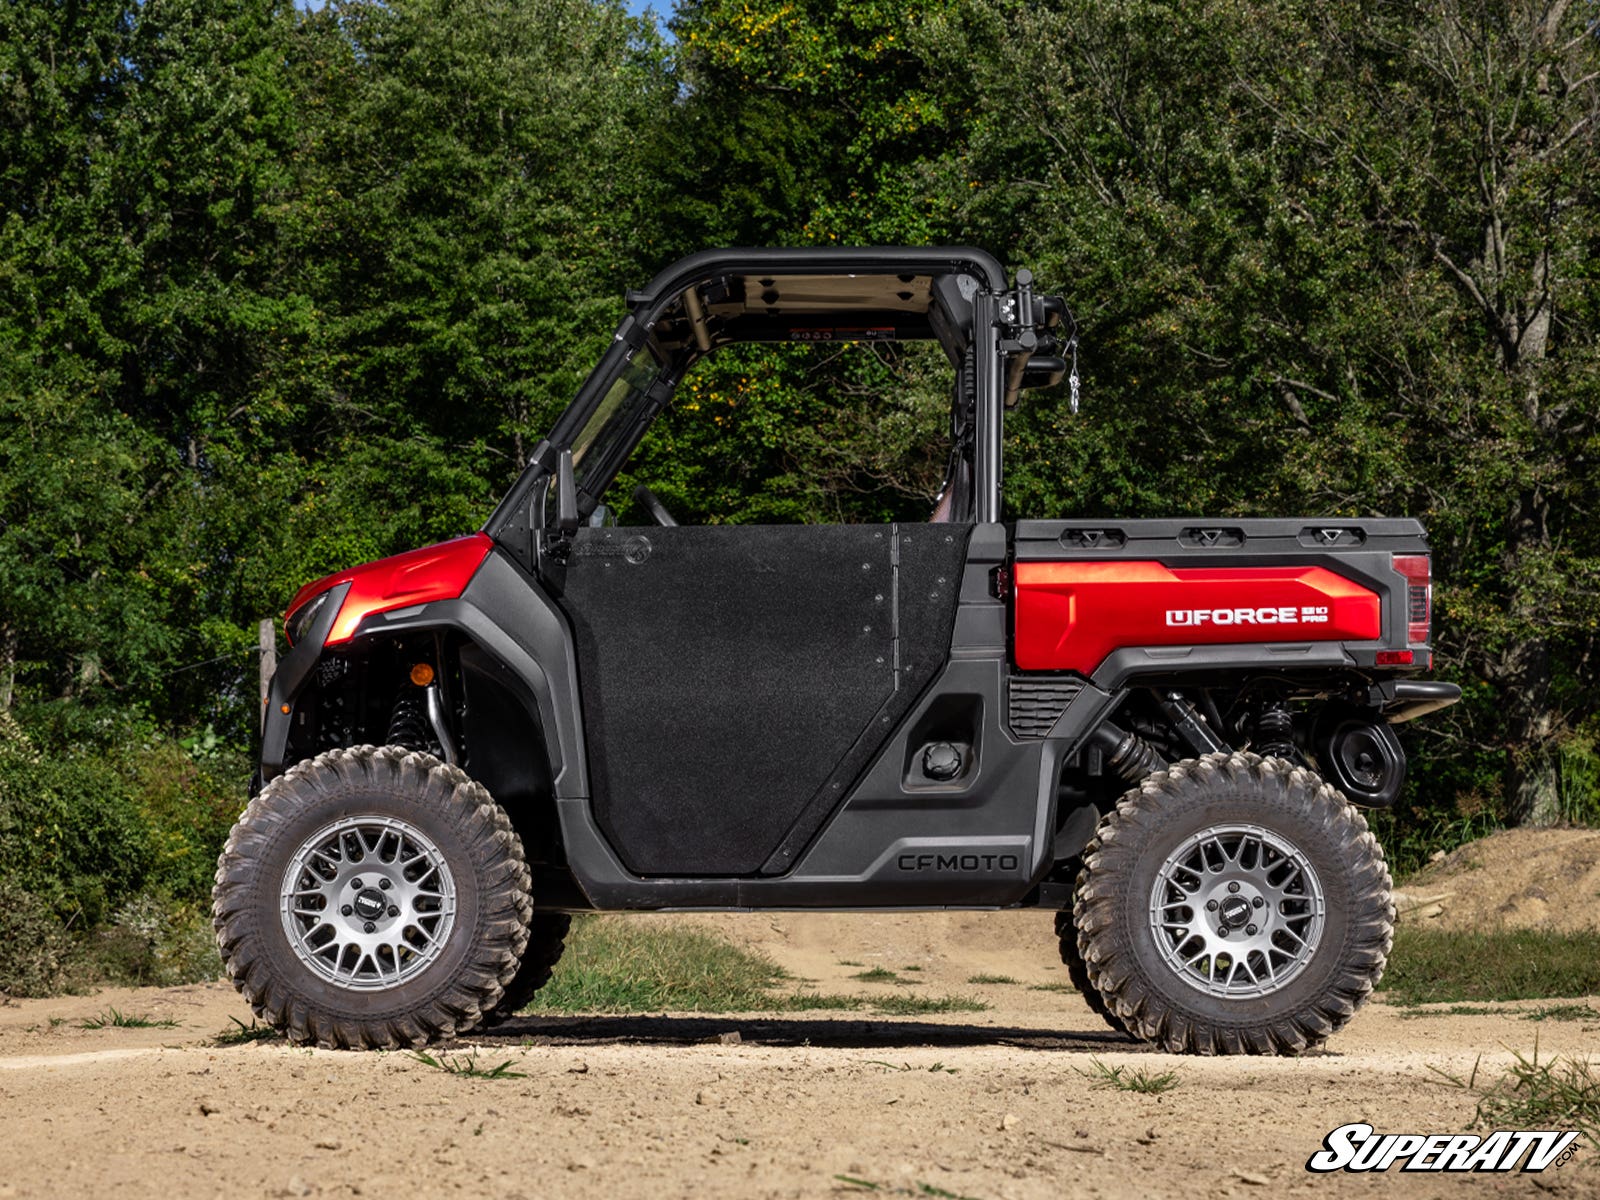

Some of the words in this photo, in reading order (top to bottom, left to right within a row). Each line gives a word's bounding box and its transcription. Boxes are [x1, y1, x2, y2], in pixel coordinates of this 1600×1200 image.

[1166, 607, 1298, 626] UFORCE
[1301, 615, 1328, 623] PRO
[898, 855, 1018, 871] CFMOTO
